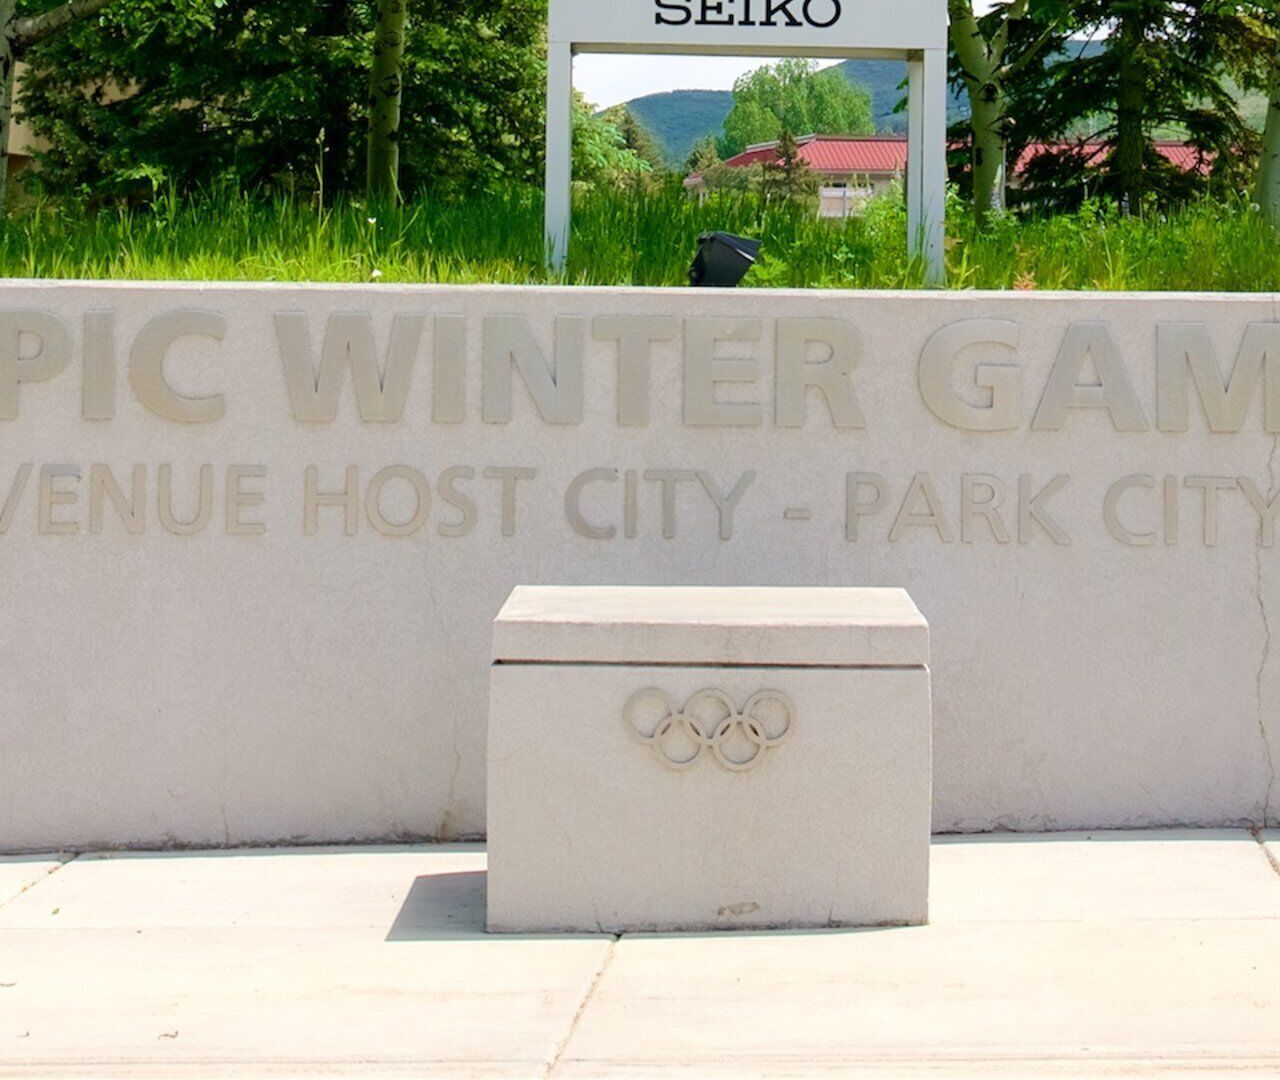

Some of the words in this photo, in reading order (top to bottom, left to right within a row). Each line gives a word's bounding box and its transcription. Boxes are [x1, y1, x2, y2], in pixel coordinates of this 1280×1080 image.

[273, 310, 866, 430] WINTER
[303, 465, 537, 538] HOST
[564, 467, 756, 541] CITY
[845, 471, 1071, 547] PARK
